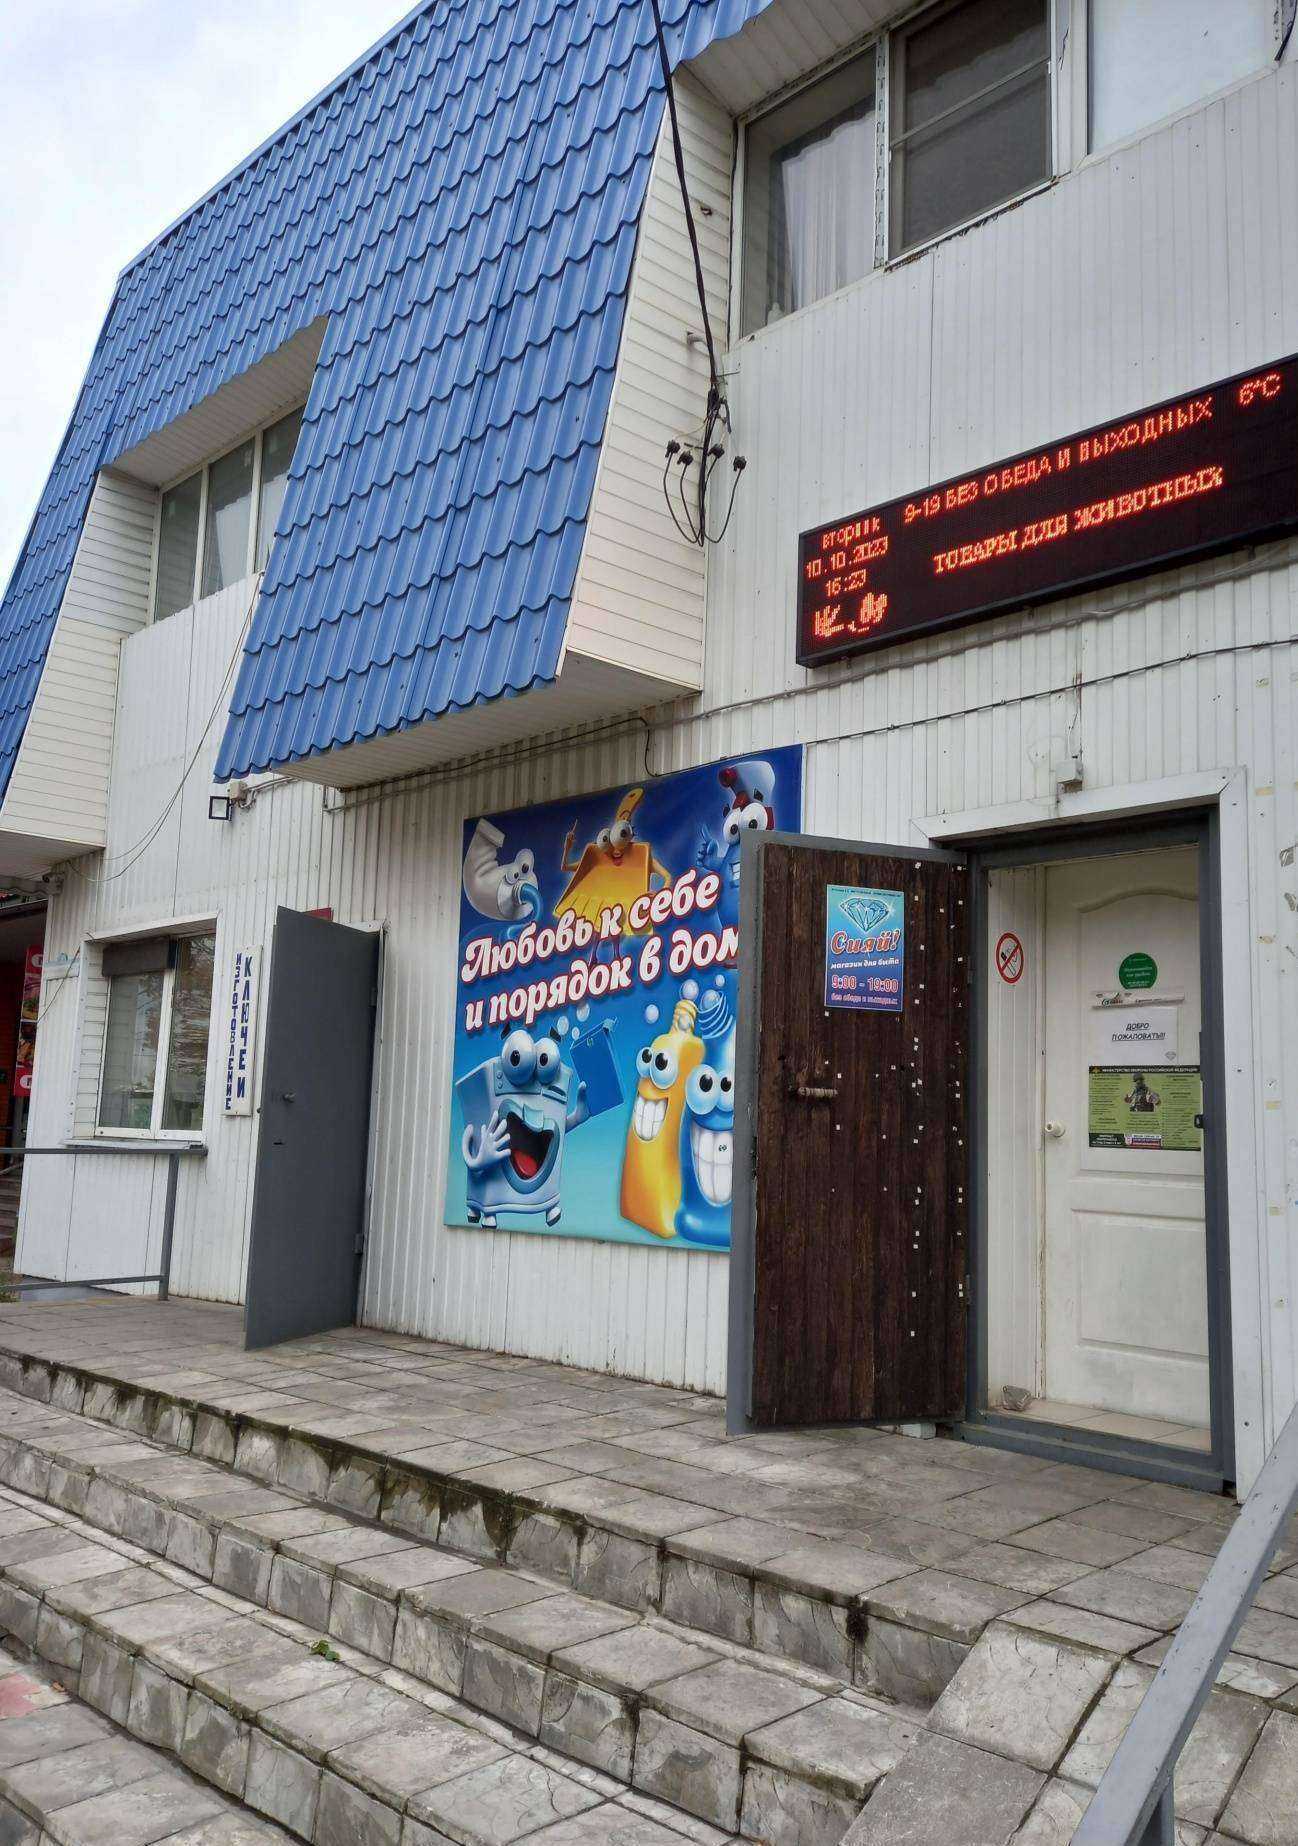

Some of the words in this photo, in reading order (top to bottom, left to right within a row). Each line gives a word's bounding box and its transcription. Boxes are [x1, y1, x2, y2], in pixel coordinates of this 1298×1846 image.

[904, 494, 941, 524] 9-19
[946, 481, 978, 509] БЕЗ
[984, 456, 1052, 495] ОБЕДА
[1058, 448, 1070, 471] И
[1079, 397, 1213, 463] ВЫХОДНЫХ
[933, 530, 1018, 574] ТОВАРЫ
[1021, 514, 1068, 550] ДЛЯ
[1074, 466, 1224, 530] ЖИВОТНЫХ
[461, 908, 593, 983] Любовь
[599, 904, 623, 940] к
[628, 869, 720, 930] себе
[831, 928, 901, 955] Сияй!
[224, 953, 242, 1110] ИЗГОТОВЛЕНИЕ
[465, 999, 483, 1031] и
[488, 956, 632, 1025] порядок
[639, 936, 663, 982] в
[831, 974, 857, 990] 9:00
[867, 976, 899, 993] 19:00
[1126, 1022, 1149, 1031] ДОБРО
